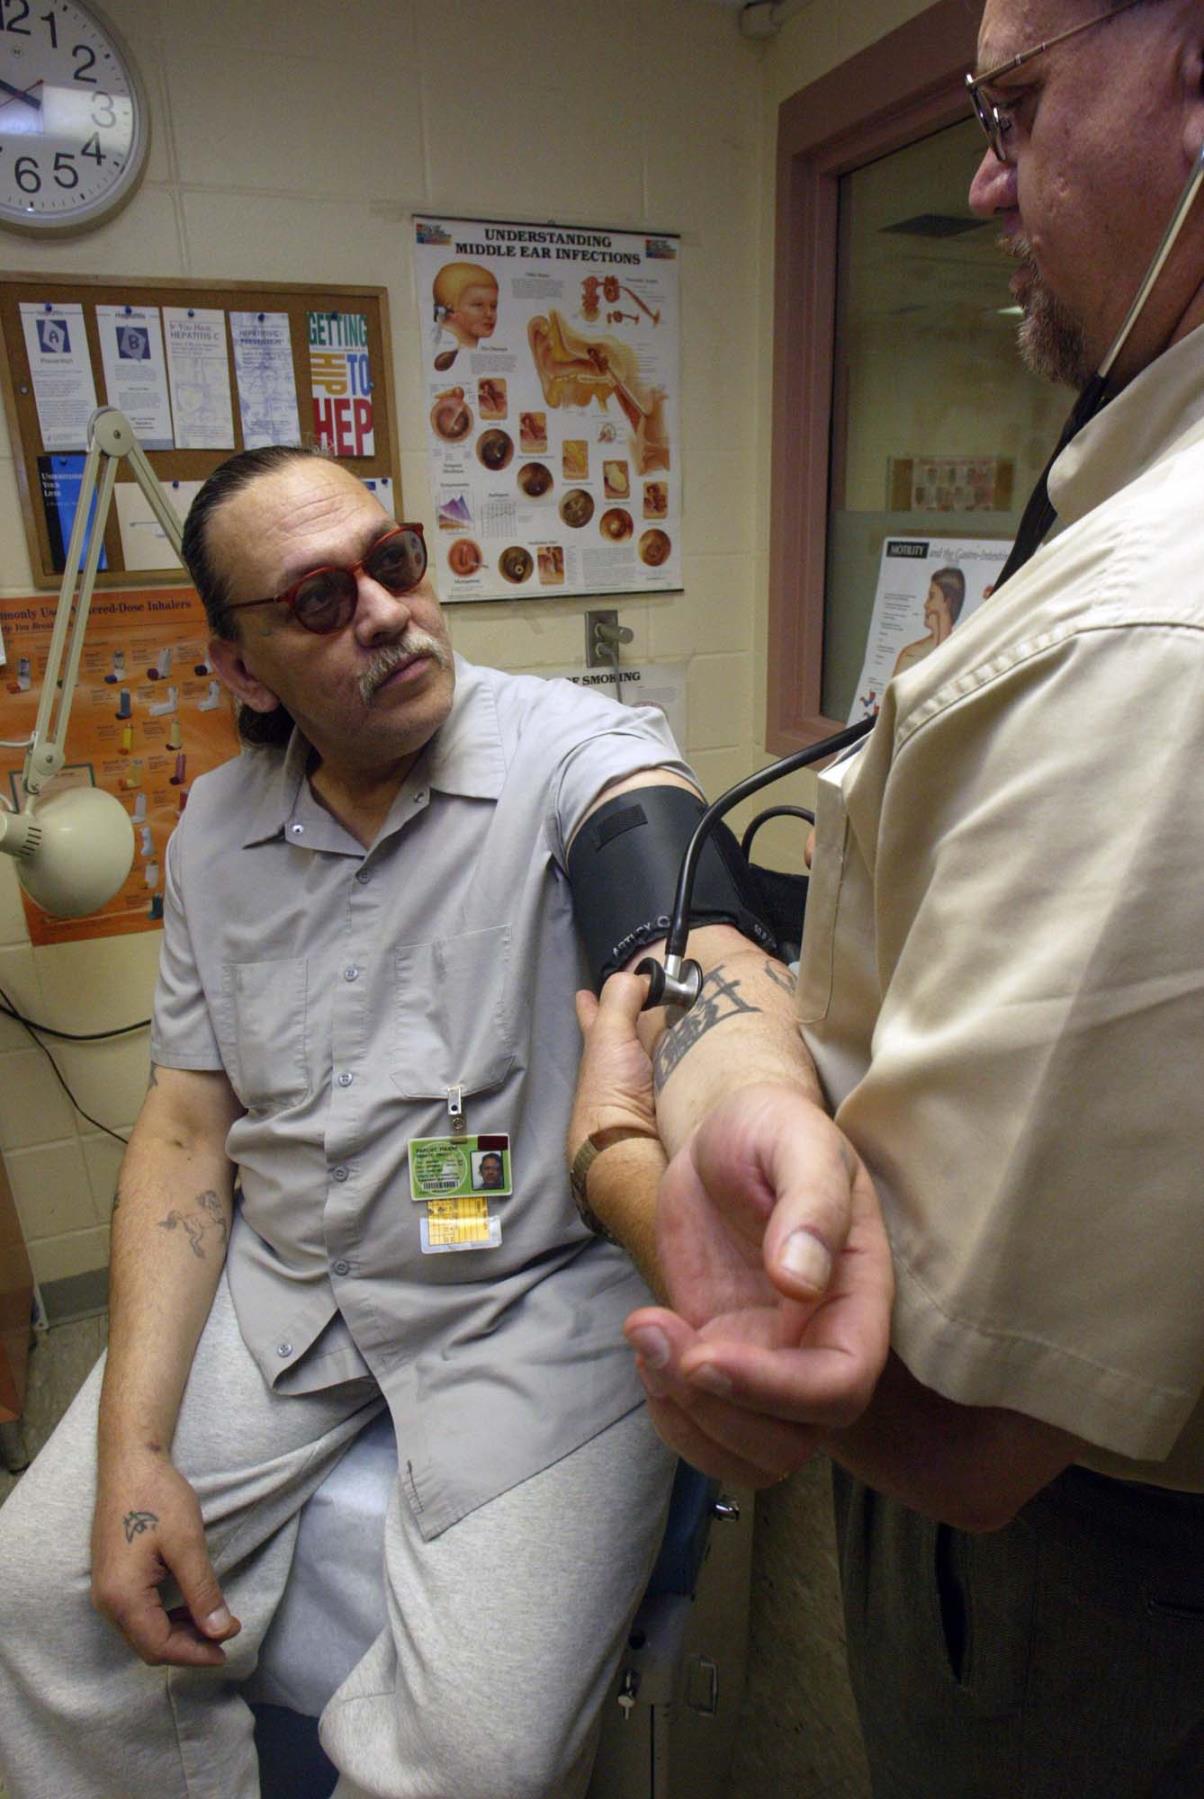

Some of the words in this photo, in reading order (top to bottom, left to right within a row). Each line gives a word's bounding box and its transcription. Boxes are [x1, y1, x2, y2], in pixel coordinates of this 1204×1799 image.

[40, 12, 57, 48] 1
[72, 45, 97, 83] 2
[91, 91, 116, 128] 3
[81, 132, 106, 165] 4
[15, 157, 41, 193] 6
[54, 153, 79, 189] 5
[455, 243, 517, 258] MIDDLE
[519, 246, 551, 260] EAR
[555, 249, 641, 265] INFECTIONS
[484, 228, 612, 248] UNDERSTANDING
[48, 330, 60, 344] A
[128, 334, 140, 350] B
[309, 312, 367, 347] GETTING
[311, 352, 348, 396] HIP
[347, 354, 372, 397] TO
[312, 398, 374, 457] HEP
[147, 599, 192, 611] Inhalers
